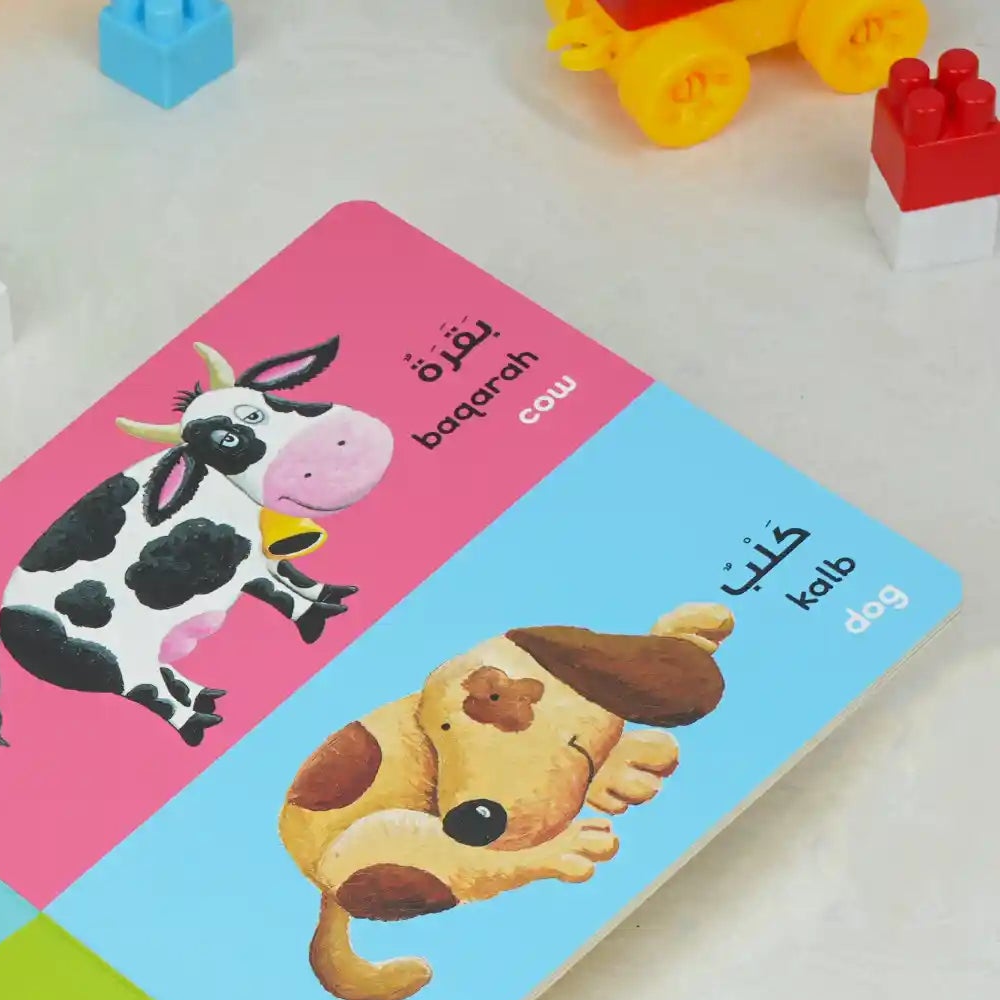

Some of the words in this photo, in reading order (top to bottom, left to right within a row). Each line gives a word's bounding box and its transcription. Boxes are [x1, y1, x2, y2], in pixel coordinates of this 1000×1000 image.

[411, 351, 539, 449] baqarah
[519, 375, 577, 424] cow
[785, 557, 856, 610] kalb
[845, 584, 909, 635] dog
